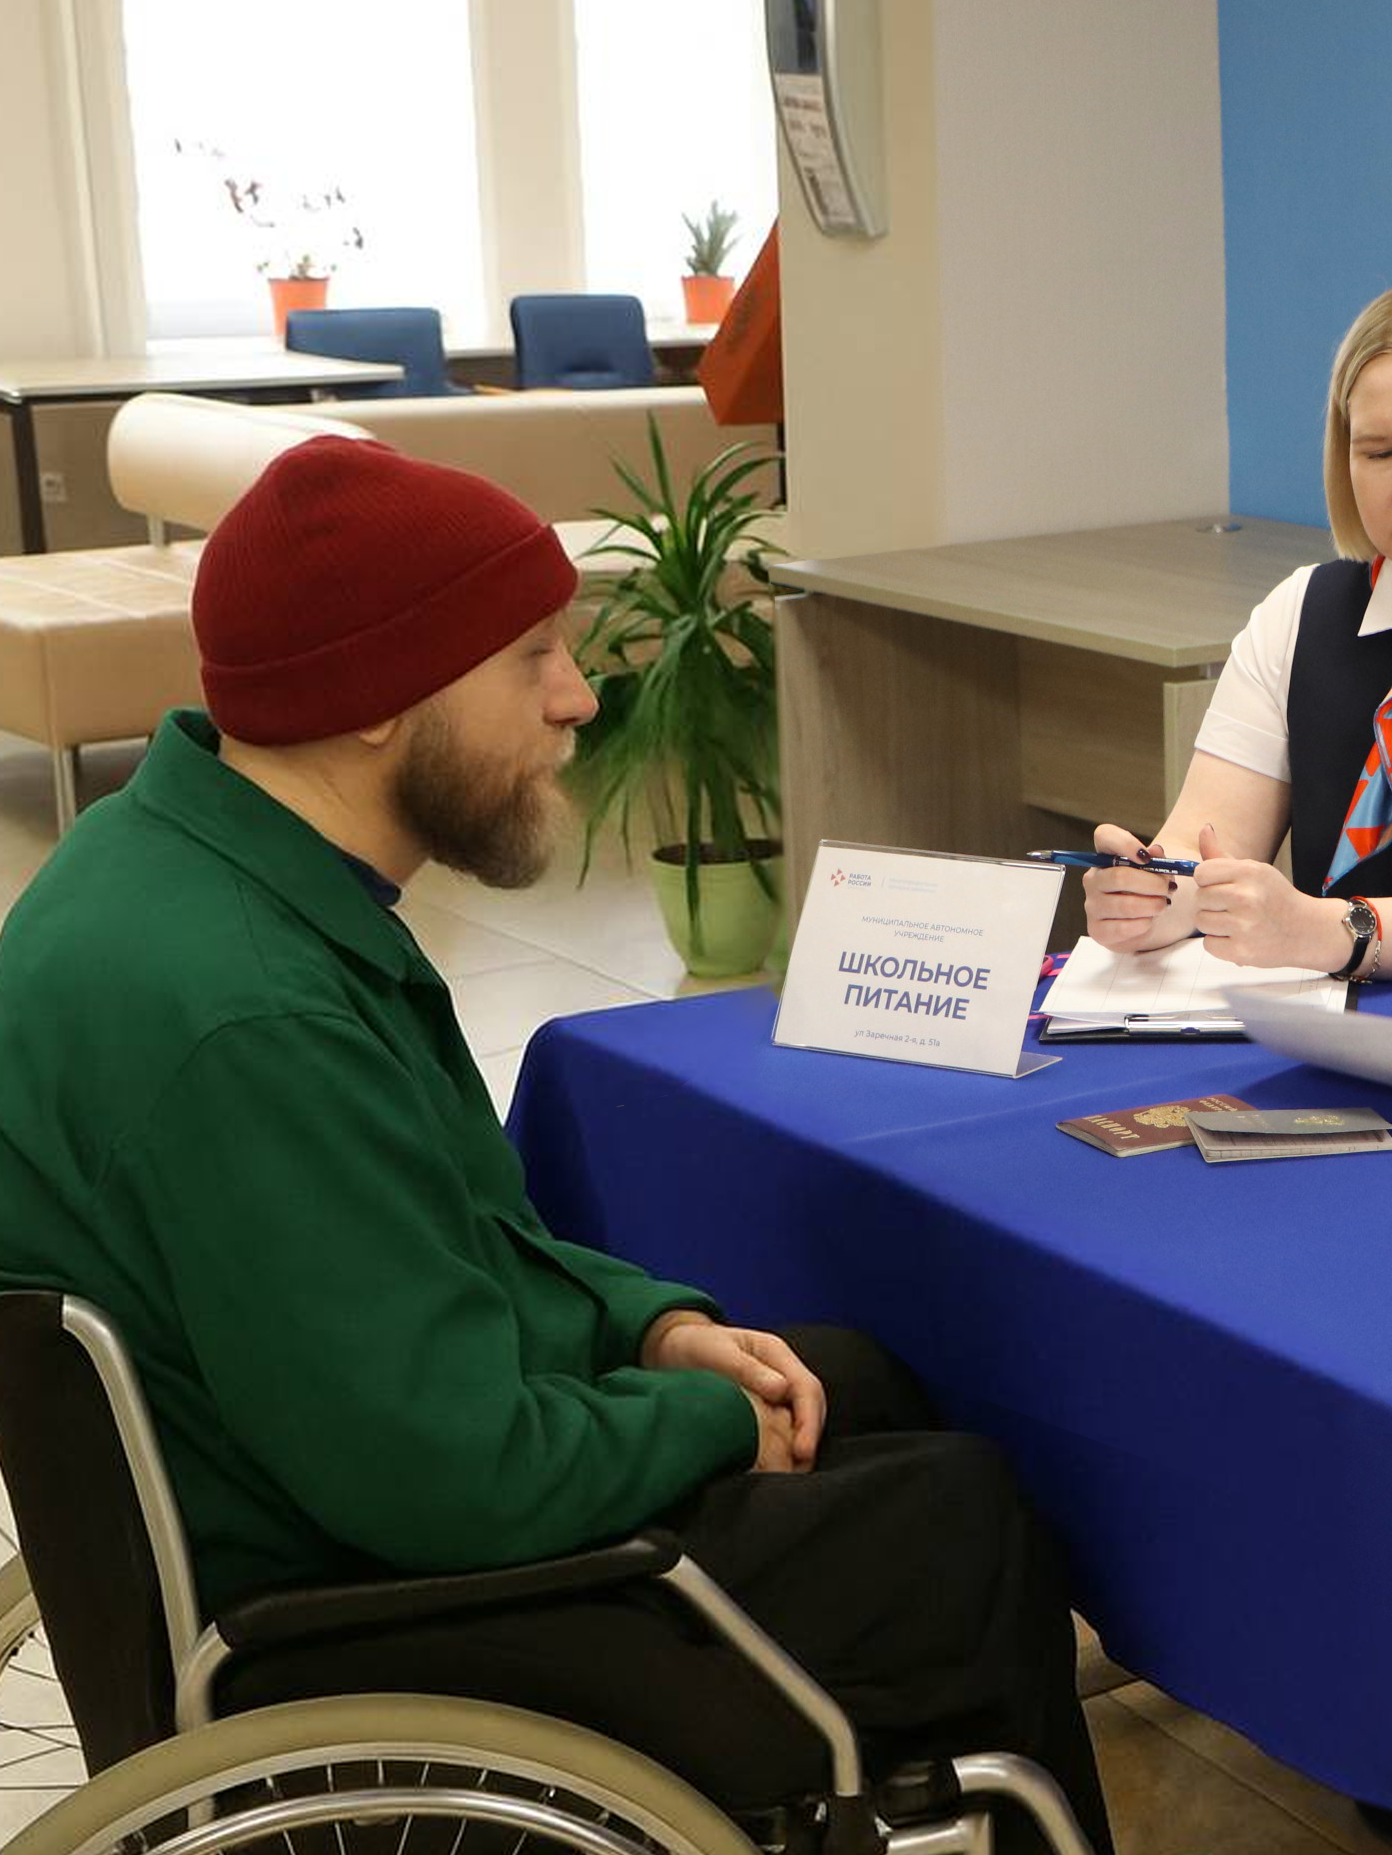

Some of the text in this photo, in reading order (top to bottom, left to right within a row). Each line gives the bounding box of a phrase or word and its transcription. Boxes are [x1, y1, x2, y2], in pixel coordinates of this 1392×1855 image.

[847, 879, 871, 887] РОССИИ
[849, 873, 871, 881] РАБОТА
[861, 915, 984, 937] МУНИЦИПАЛЬНОЕ АВТОНОМНОЕ
[894, 930, 945, 942] УЧРЕЖДЕНИЕ
[838, 951, 991, 990] ШКОЛЬНОЕ
[844, 984, 970, 1020] ПИТАНИЕ
[865, 1030, 903, 1042] Заречная
[928, 1038, 941, 1047] 51а
